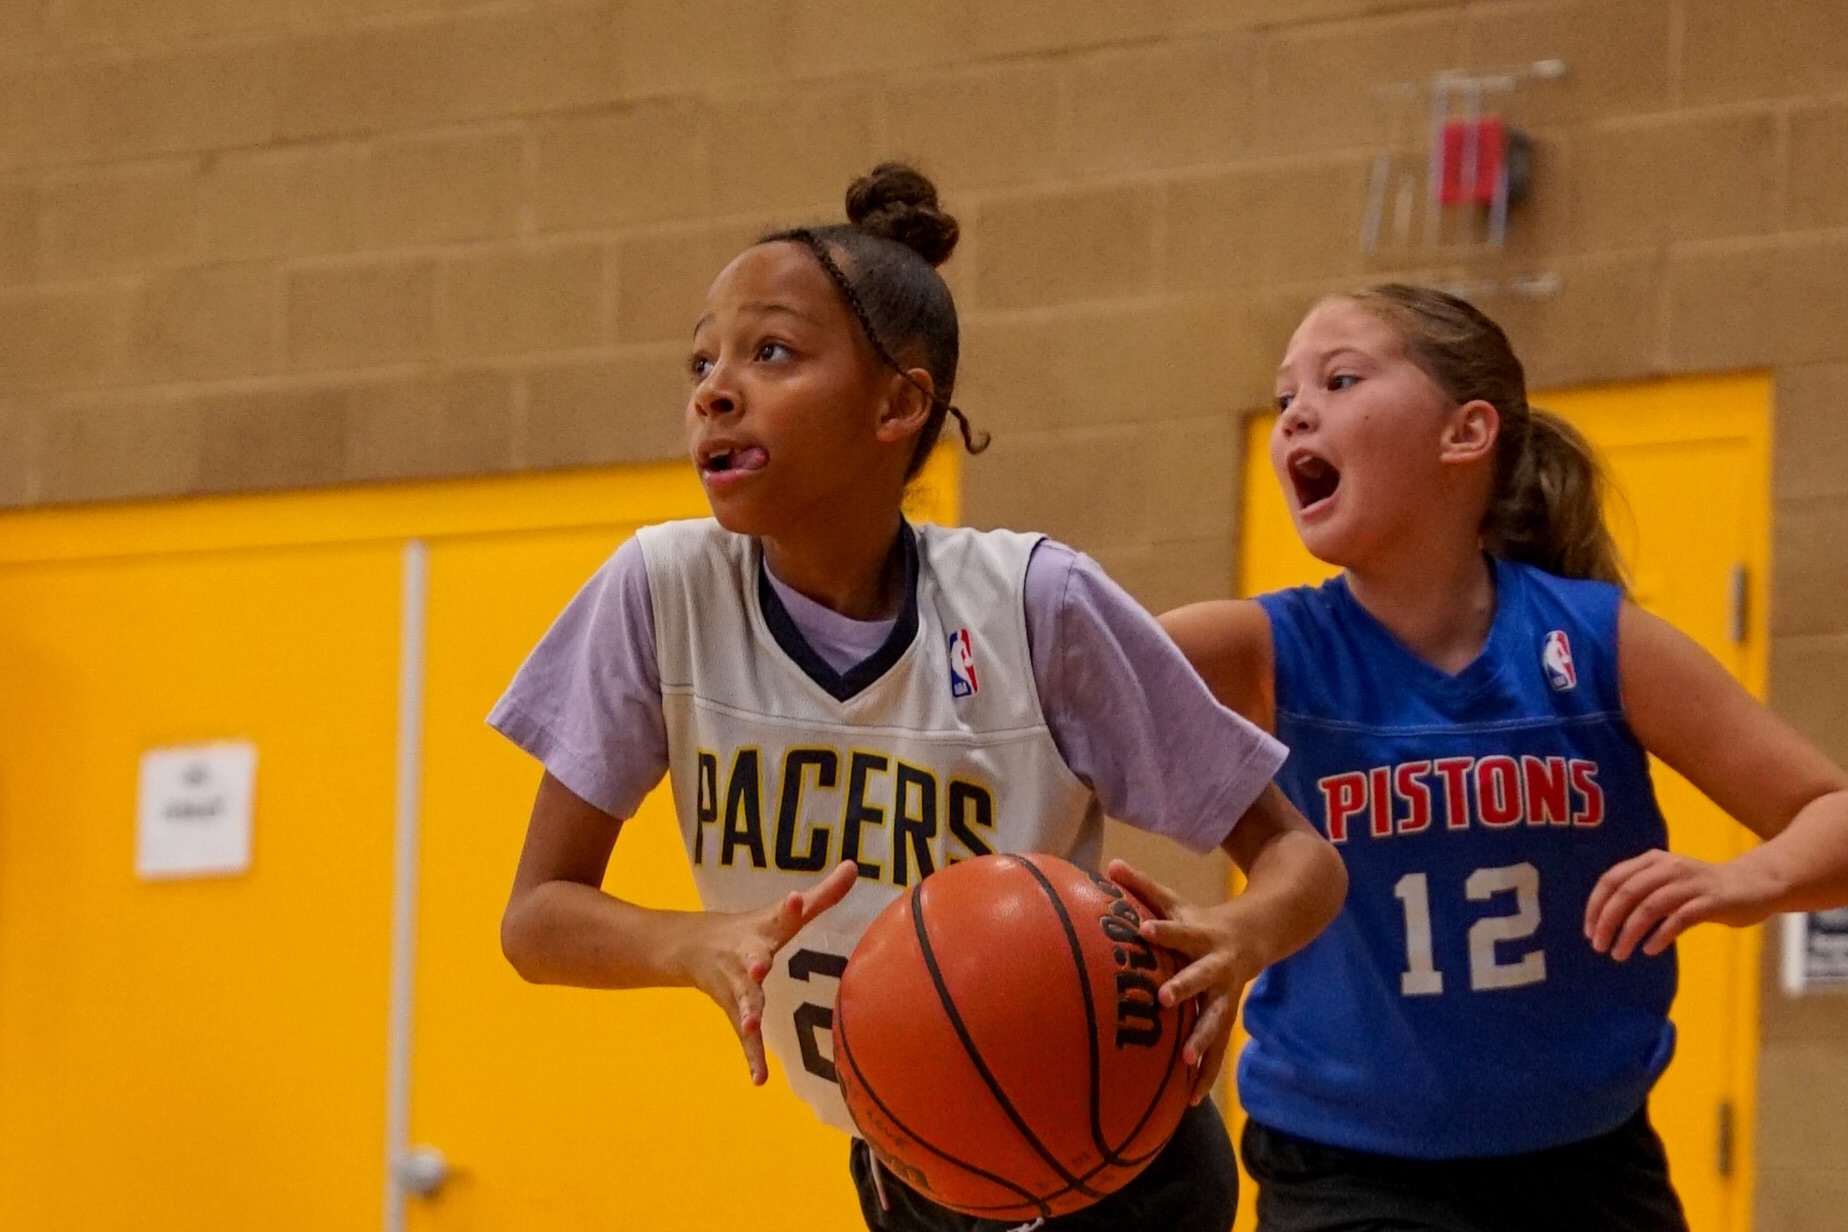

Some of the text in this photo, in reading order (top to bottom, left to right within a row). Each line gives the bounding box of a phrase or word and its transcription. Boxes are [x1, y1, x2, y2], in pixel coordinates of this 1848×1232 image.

[693, 744, 996, 888] PACERS
[1317, 754, 1605, 843] PISTONS
[1393, 861, 1547, 996] 12
